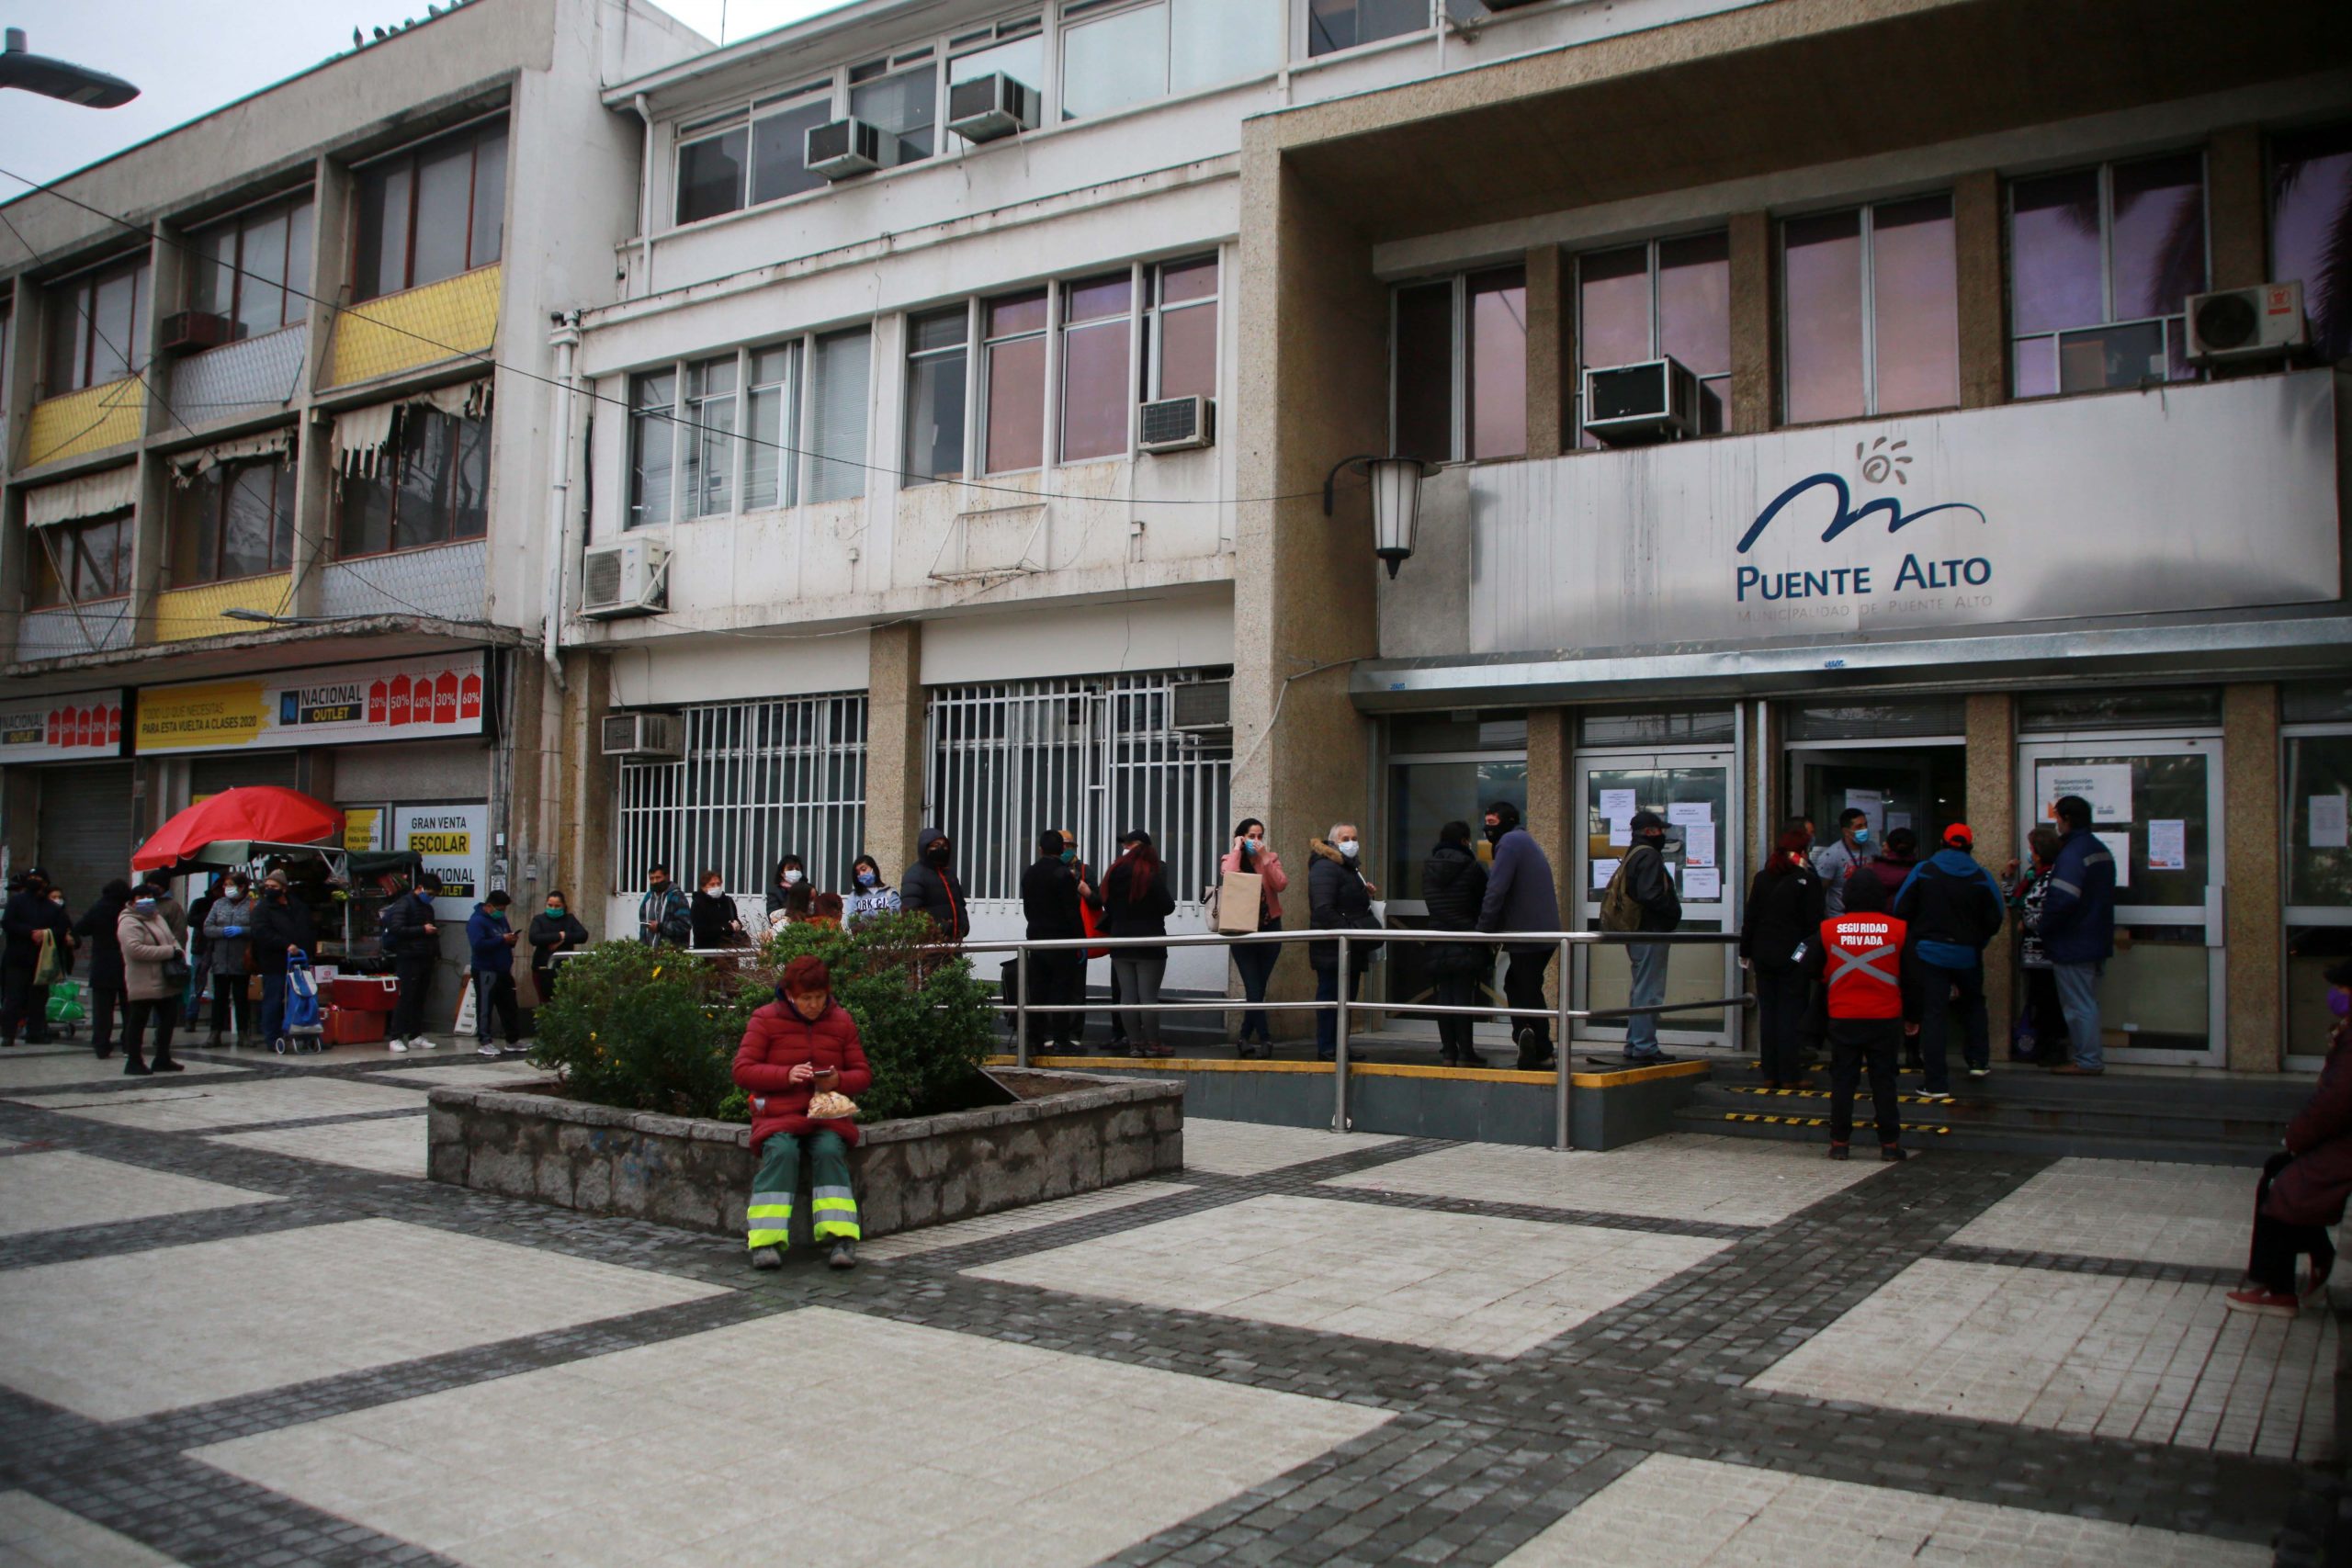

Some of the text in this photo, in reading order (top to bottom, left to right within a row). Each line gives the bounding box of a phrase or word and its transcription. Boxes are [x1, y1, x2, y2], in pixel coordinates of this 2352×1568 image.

[1736, 553, 1992, 602] PUENTE ALTO
[1860, 603, 1878, 615] DE
[1889, 598, 1944, 613] PUENTE
[1955, 595, 1993, 609] ALTO
[301, 684, 363, 706] NACIONAL
[370, 692, 480, 709] 20% 50% 40% 30% 60%
[187, 702, 224, 716] NECESITAS
[313, 706, 349, 721] OUTLET
[2, 713, 43, 729] NACIONAL
[141, 716, 257, 734] PARA ESTA VUELTA A CLASES 2020
[412, 817, 467, 829] GRAN VENTA
[411, 836, 467, 852] ESCOLAR
[1837, 923, 1888, 934] SEGURIDAD
[1840, 935, 1883, 946] PRIVADA
